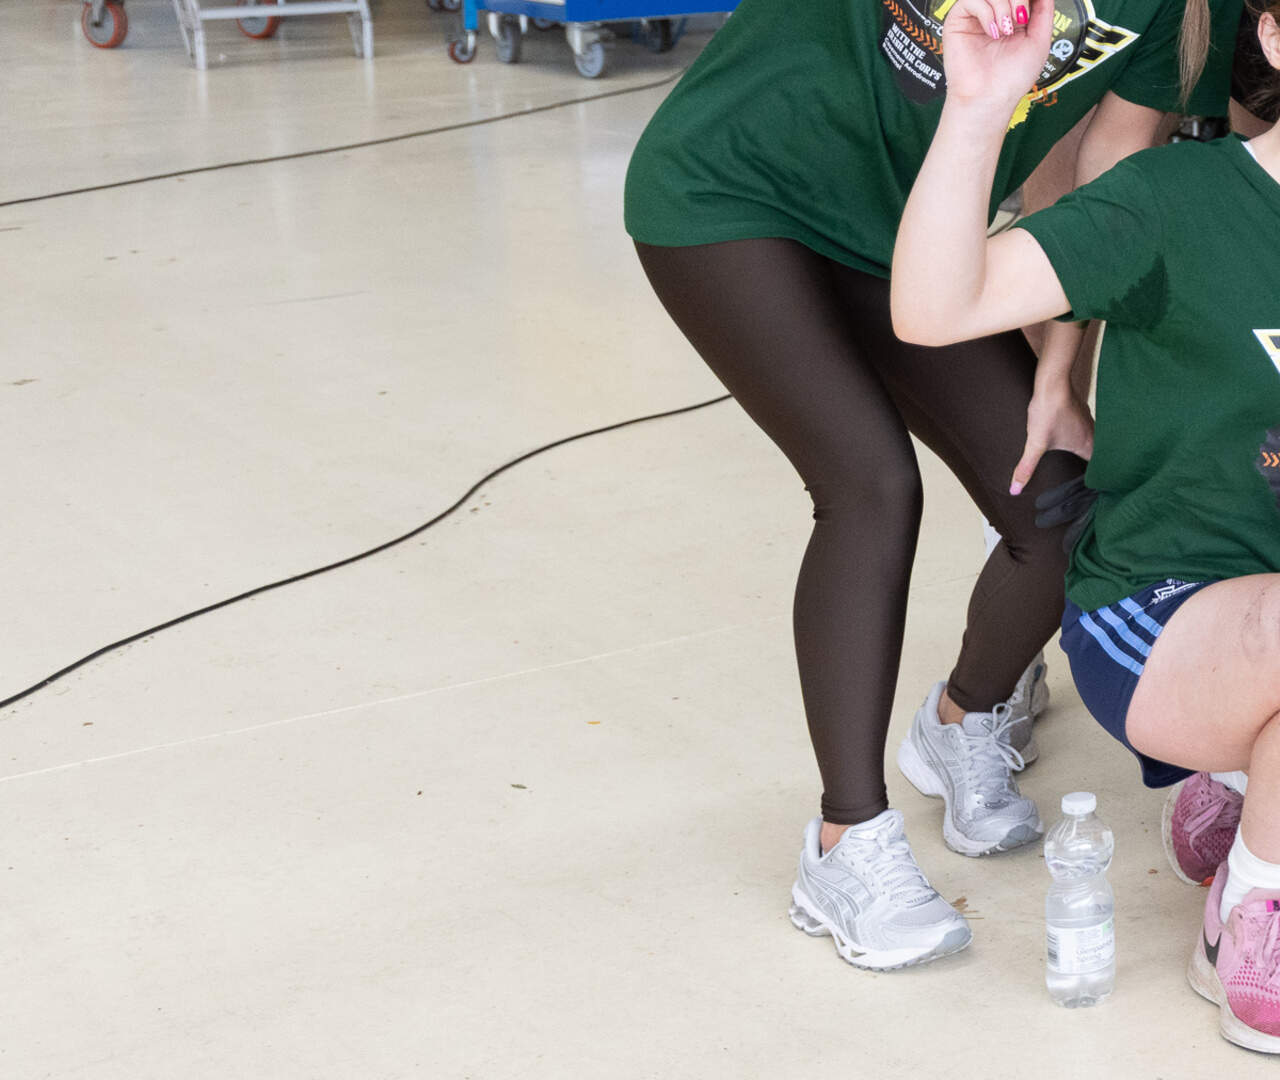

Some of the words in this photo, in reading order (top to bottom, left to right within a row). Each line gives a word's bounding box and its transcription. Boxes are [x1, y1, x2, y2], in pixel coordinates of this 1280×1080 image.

[887, 30, 905, 51] IRISH
[902, 48, 916, 65] AIR
[914, 60, 943, 81] CORPS
[891, 22, 910, 46] WITH
[909, 39, 926, 60] THE
